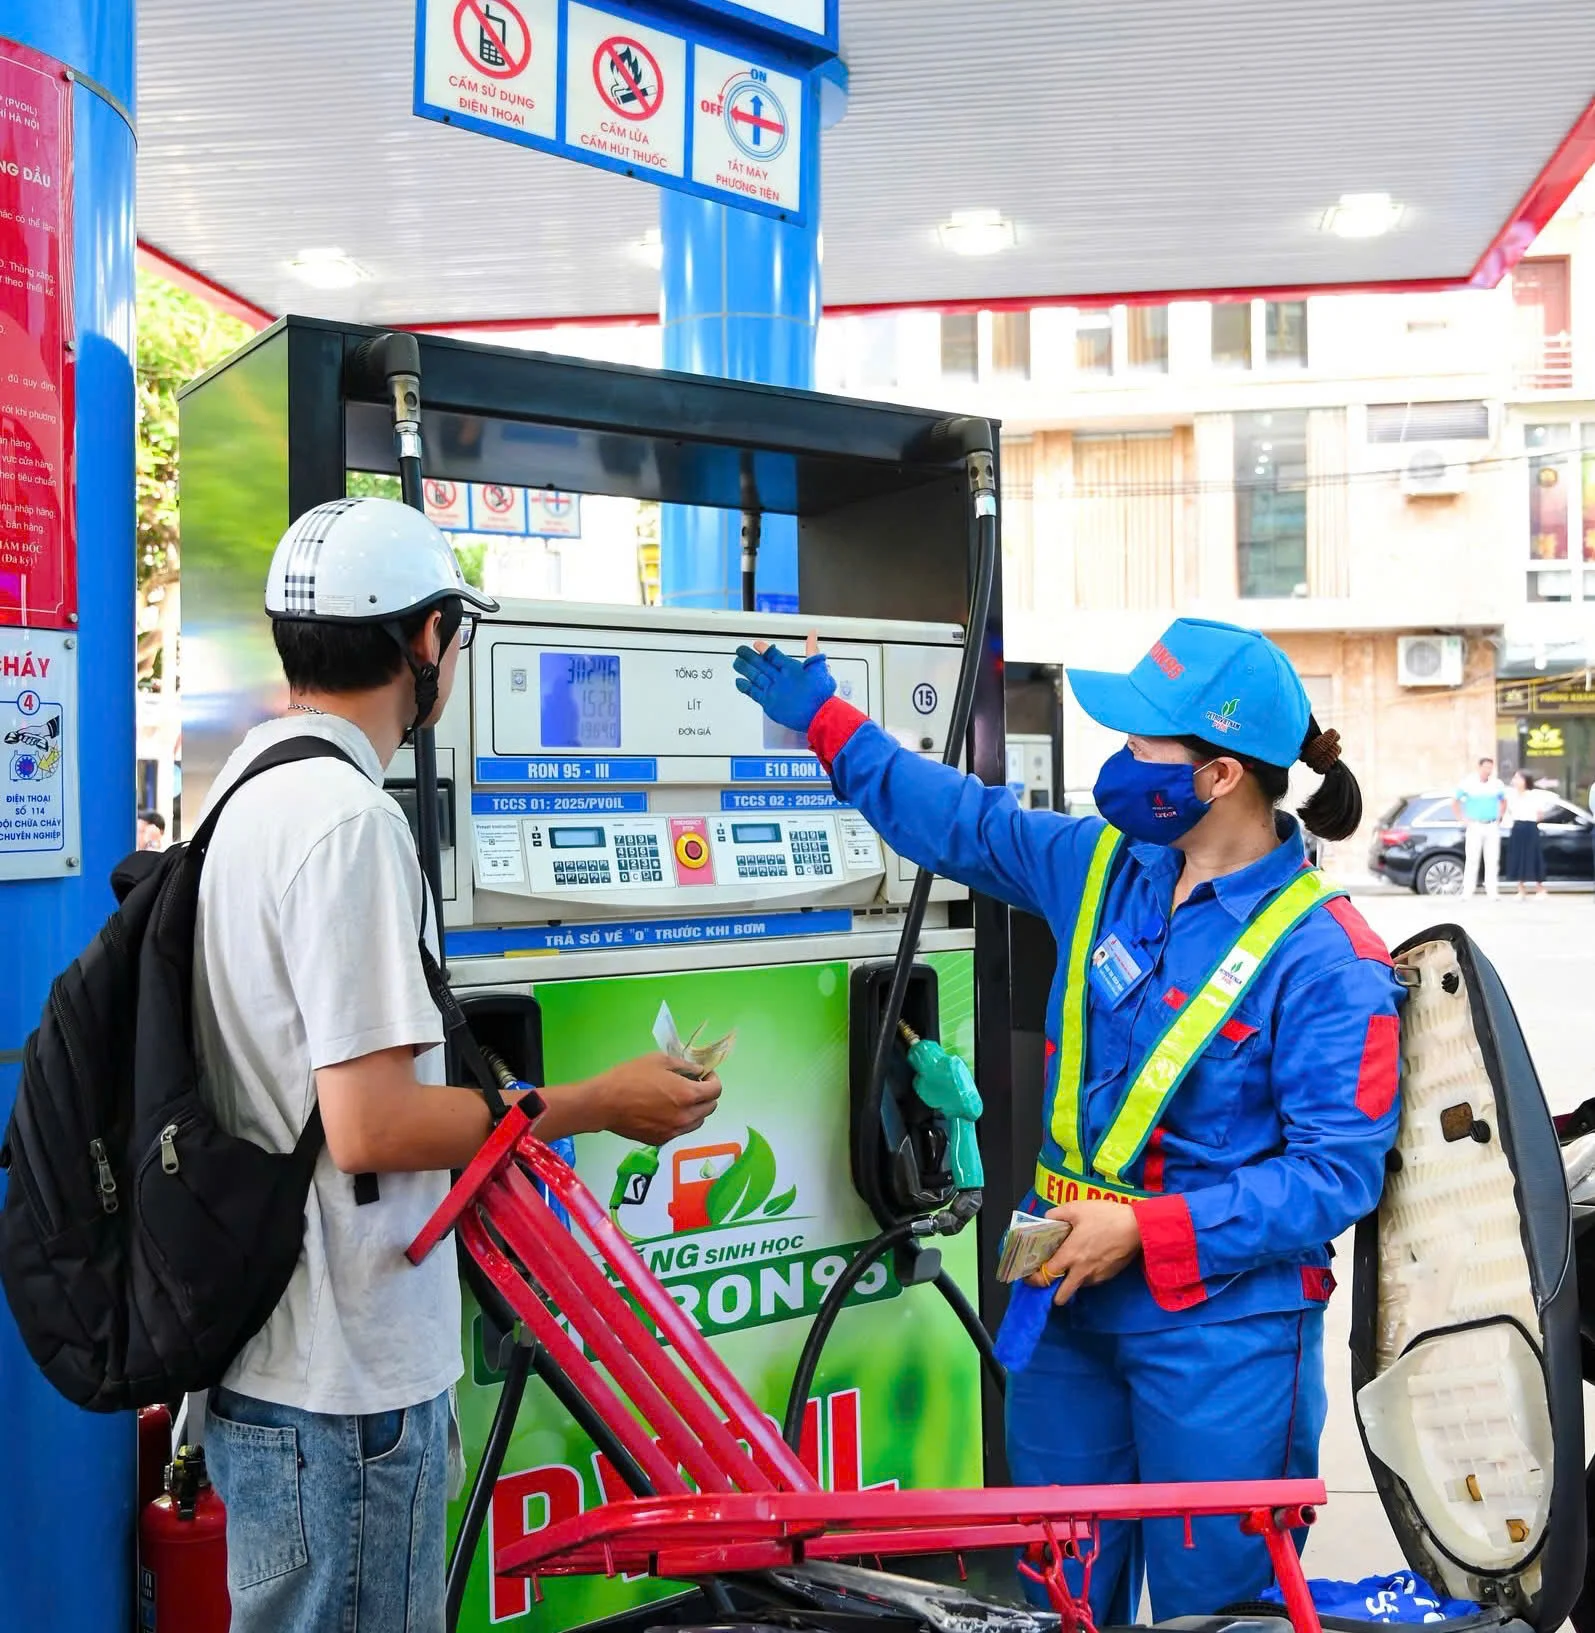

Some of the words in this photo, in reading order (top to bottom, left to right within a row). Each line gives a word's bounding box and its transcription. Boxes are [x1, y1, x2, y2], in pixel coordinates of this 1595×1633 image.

[750, 69, 767, 83] ON
[448, 75, 478, 92] CẤM
[481, 83, 496, 97] SỬ
[500, 90, 535, 109] DỤNG
[5, 97, 38, 118] (PVOIL)
[459, 97, 488, 114] ĐIỆN
[491, 106, 525, 126] THOẠI
[701, 100, 723, 116] OFF
[9, 111, 22, 124] HÀ
[24, 117, 40, 130] NỘI
[600, 122, 626, 138] CẤM
[629, 128, 649, 144] LỬA
[580, 134, 607, 150] CẤM
[610, 142, 630, 157] HÚT
[632, 149, 667, 168] THUỐC
[716, 174, 757, 194] PHƯƠNG
[5, 275, 24, 288] theo
[23, 378, 38, 390] quy
[15, 405, 28, 417] khi
[18, 472, 33, 483] tiêu
[0, 651, 50, 678] HÁY
[675, 666, 698, 679] TỔNG
[701, 667, 713, 679] SỐ
[24, 694, 33, 711] 4
[687, 698, 702, 711] LÍT
[918, 690, 933, 707] 15
[678, 727, 696, 736] ĐƠN
[697, 726, 711, 736] GIÁ
[528, 763, 559, 778] RON
[563, 763, 581, 778] 95
[595, 763, 610, 778] III
[765, 763, 789, 777] E10
[791, 762, 817, 777] RON
[6, 794, 25, 804] ĐIỆN
[28, 795, 51, 804] THOẠI
[492, 798, 527, 810] TCCS
[554, 797, 625, 810] 2025/PVOIL
[733, 795, 766, 807] TCCS
[769, 795, 785, 807] 02
[15, 805, 27, 815] SỐ
[32, 807, 45, 815] 114
[15, 818, 38, 828] CHỮA
[33, 830, 61, 840] NGHIỆP
[544, 930, 574, 946] TRẢ
[580, 929, 600, 944] SỐ
[604, 928, 623, 943] VỀ
[655, 925, 702, 939] TRƯỚC
[705, 925, 729, 936] KHI
[734, 923, 765, 935] BƠM
[1047, 1174, 1079, 1204] E10
[601, 1243, 700, 1282] NG
[704, 1242, 756, 1265] SINH
[760, 1235, 804, 1257] HỌC
